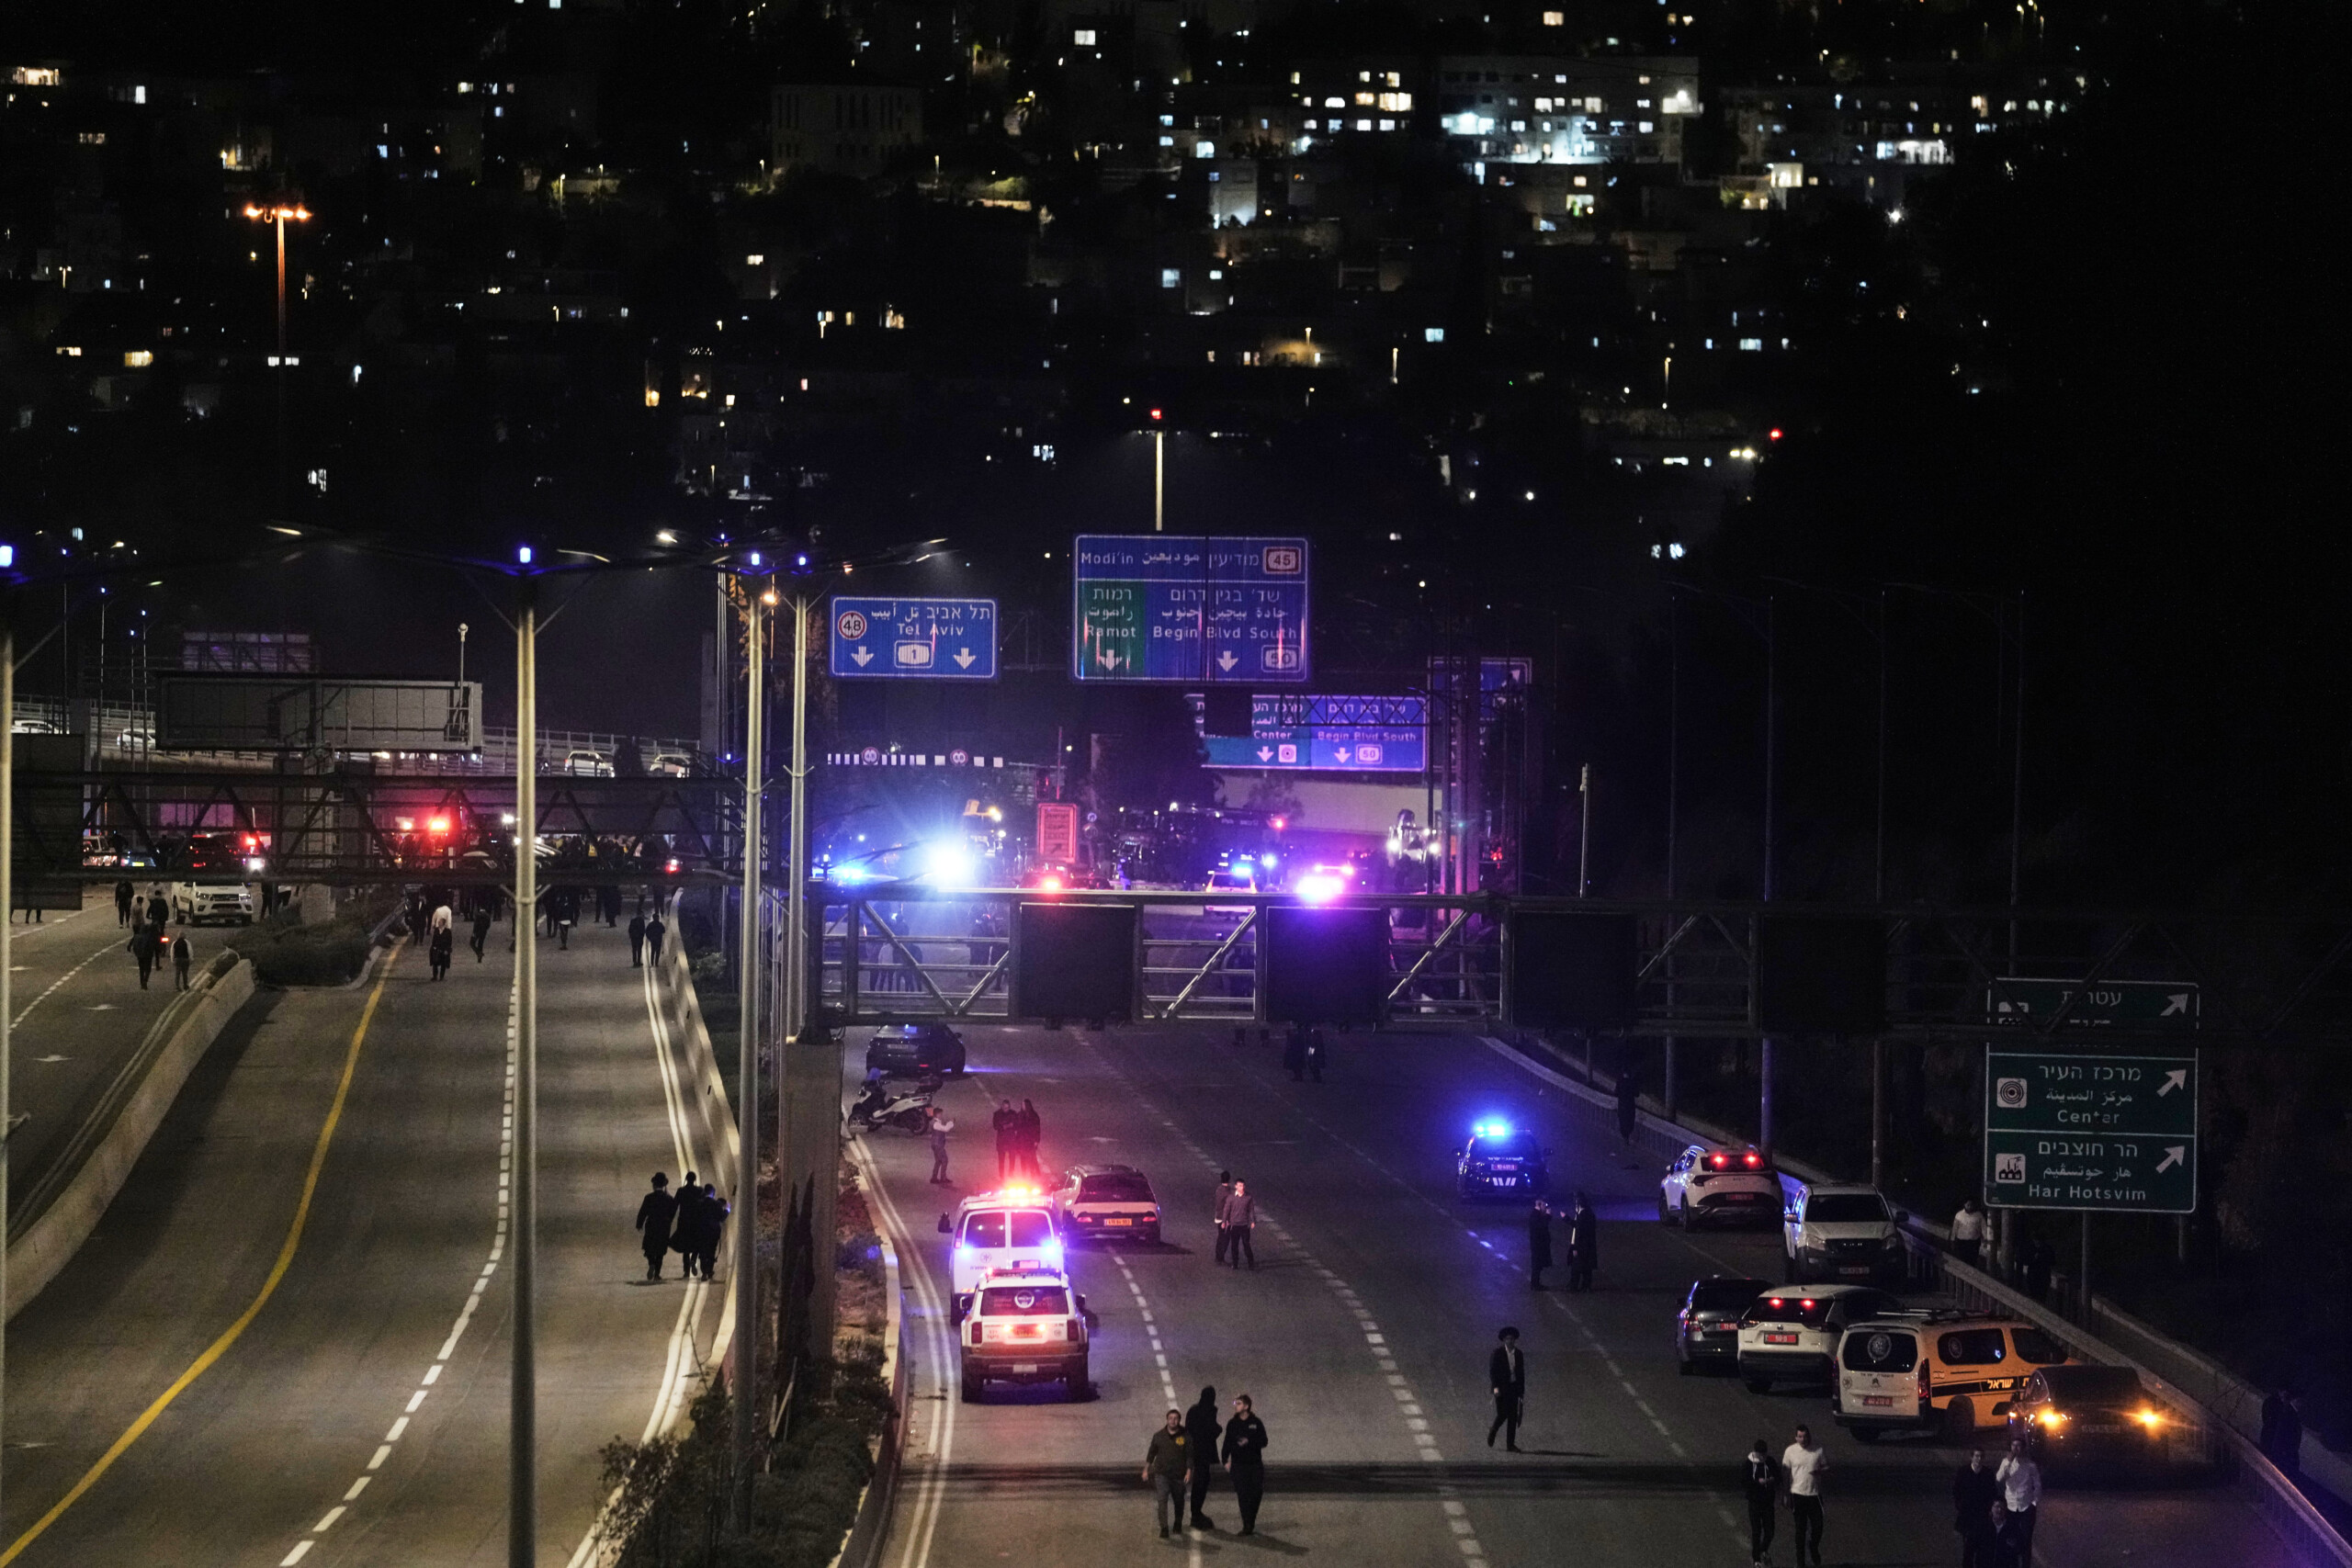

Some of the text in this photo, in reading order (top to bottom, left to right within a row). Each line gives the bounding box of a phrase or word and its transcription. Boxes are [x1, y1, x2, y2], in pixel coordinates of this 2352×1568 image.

[1081, 551, 1134, 564] Modi'in
[1208, 553, 1260, 570] מודיעין
[1273, 554, 1291, 566] 45
[1093, 588, 1132, 601] רמות
[1170, 590, 1206, 602] דרום
[1216, 590, 1242, 605] בגין
[871, 602, 896, 621] أبيب
[926, 604, 990, 620] תל אביב
[898, 623, 964, 636] Tel Aviv
[1087, 625, 1136, 638] Ramot
[1153, 626, 1297, 641] Begin Blvd South
[911, 649, 917, 660] 1
[1253, 730, 1293, 739] Center
[1317, 730, 1417, 742] Begin Blvd South
[1363, 750, 1375, 759] 50
[2039, 1065, 2142, 1081] מרכז העיר
[2046, 1088, 2132, 1106] مركز المدينة
[2038, 1141, 2138, 1157] הר חוצבים
[2112, 1166, 2132, 1181] هار
[2029, 1184, 2146, 1201] Har Hotsvim
[1987, 1378, 2015, 1390] ישראל
